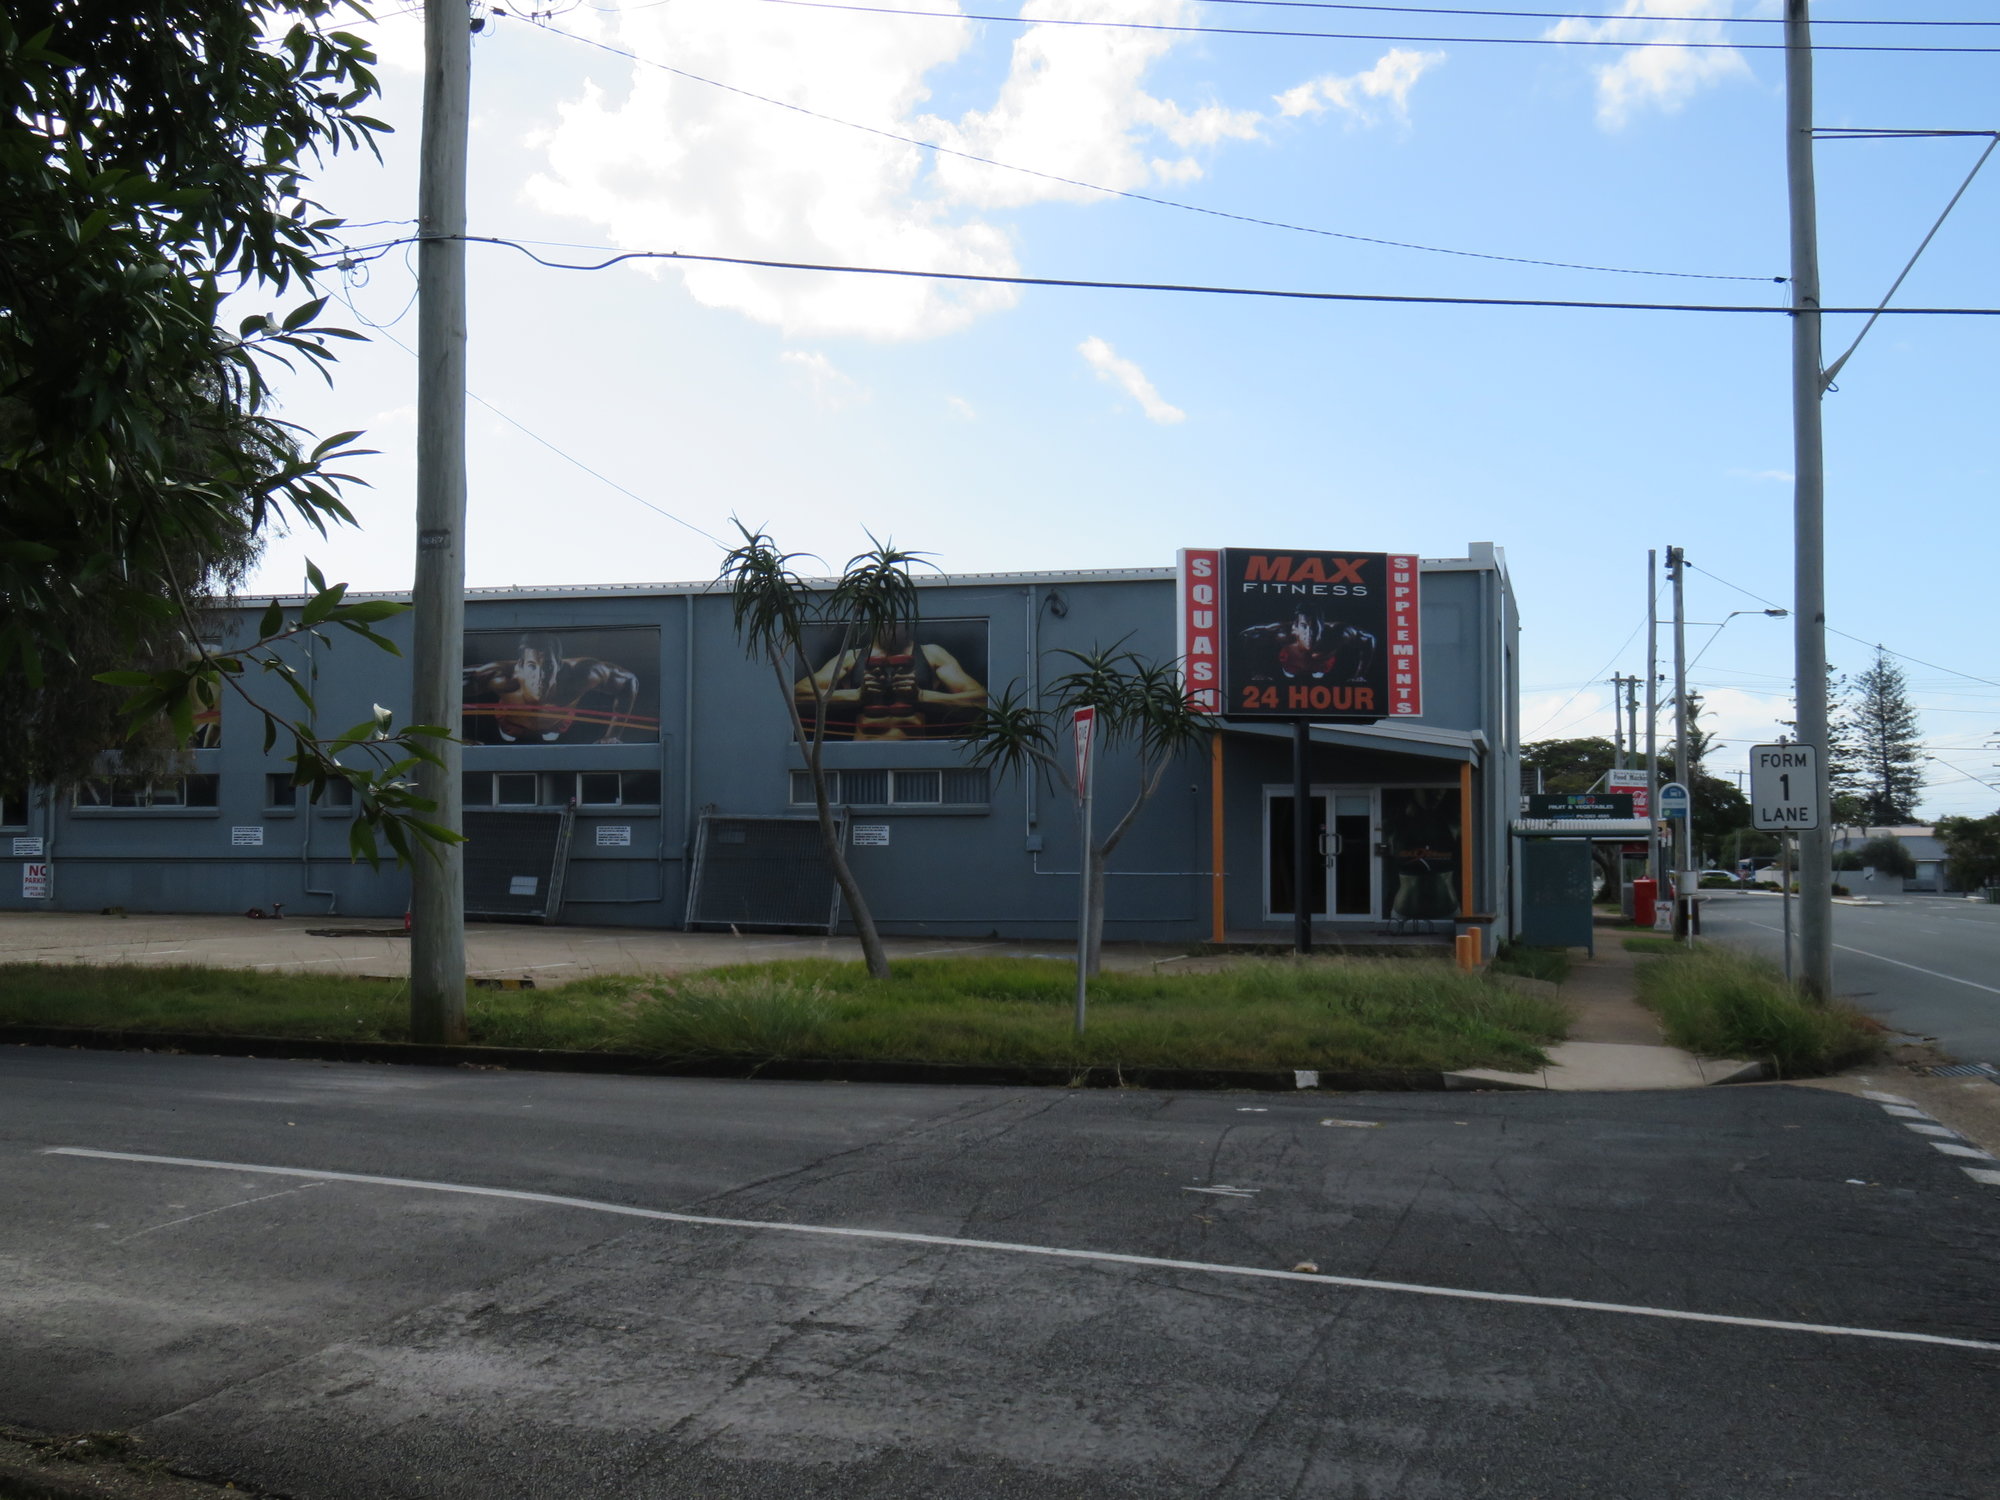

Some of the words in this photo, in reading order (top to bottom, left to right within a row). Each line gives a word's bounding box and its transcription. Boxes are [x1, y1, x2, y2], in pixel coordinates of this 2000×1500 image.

[1243, 556, 1369, 583] MAX
[1243, 583, 1368, 596] FITNESS
[1191, 558, 1214, 707] SQUASH
[1393, 558, 1413, 714] SUPPLEMENTS
[1242, 686, 1279, 709] 24
[1289, 686, 1375, 710] HOUR
[1761, 753, 1807, 768] FORM
[1780, 774, 1790, 801] 1
[1762, 807, 1809, 822] LANE
